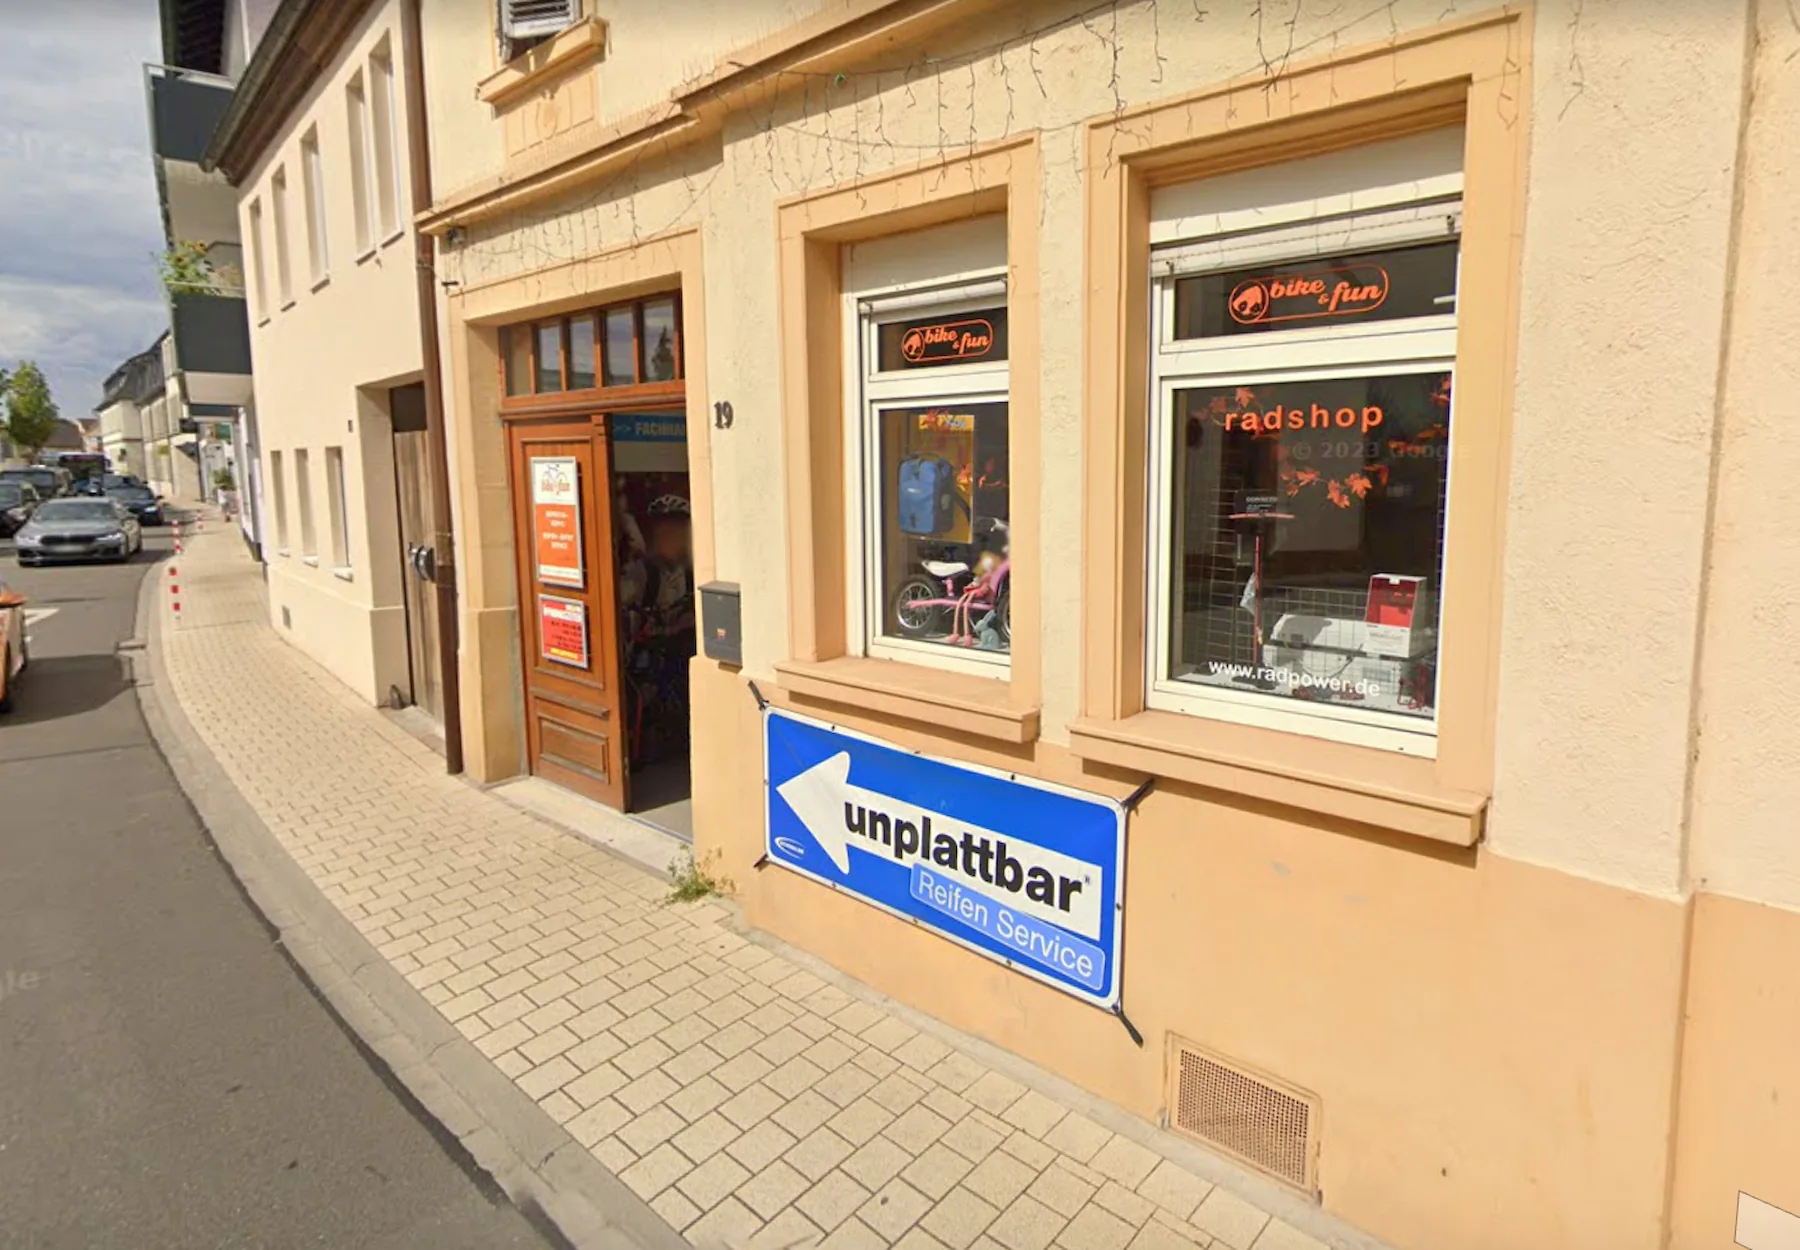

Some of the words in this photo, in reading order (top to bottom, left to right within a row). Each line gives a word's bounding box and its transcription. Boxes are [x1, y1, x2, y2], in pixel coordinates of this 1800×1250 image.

[1270, 278, 1326, 299] bike
[1328, 281, 1383, 312] fun
[924, 326, 958, 344] bike
[958, 331, 990, 354] fun
[714, 400, 734, 429] 19
[1224, 403, 1384, 433] radshop
[1208, 660, 1381, 697] www.radpower.de
[918, 870, 988, 926] Reifen
[996, 909, 1094, 978] Service
